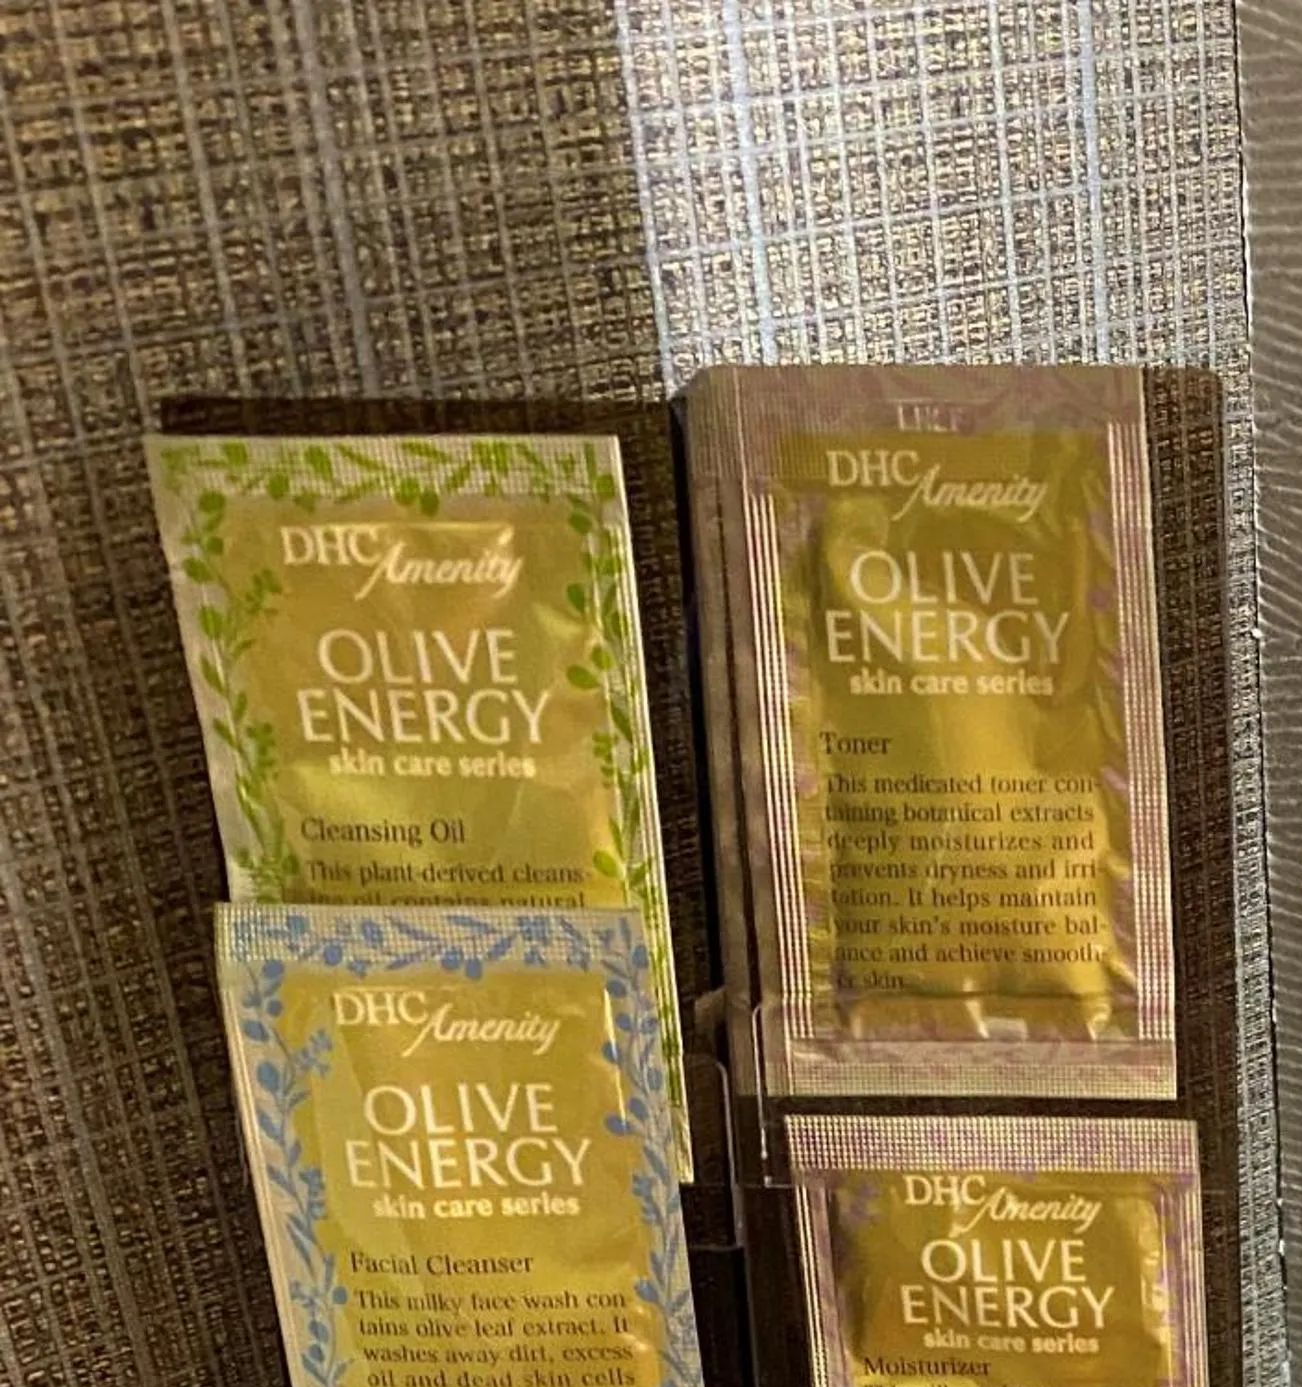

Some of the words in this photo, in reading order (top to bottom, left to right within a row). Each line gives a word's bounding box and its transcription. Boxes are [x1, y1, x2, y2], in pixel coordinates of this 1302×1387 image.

[826, 451, 920, 486] DHC
[892, 464, 1048, 522] Amenity
[281, 527, 381, 565] DHC
[354, 539, 524, 600] Amenity
[850, 550, 1038, 605] OLIVE
[318, 630, 517, 684] OLIVE
[825, 611, 1070, 664] ENERGY
[850, 668, 901, 694] skin
[911, 674, 968, 693] care
[976, 668, 1053, 695] series
[297, 691, 550, 745] ENERGY
[329, 751, 383, 776] skin
[394, 757, 451, 777] care
[458, 751, 537, 778] series
[820, 732, 892, 755] Toner
[302, 819, 422, 847] Cleansing
[430, 819, 466, 843] Oil
[932, 889, 991, 911] helps
[1000, 889, 1096, 906] maintain
[332, 991, 428, 1026] DHC
[400, 1003, 560, 1058] Amenity
[364, 1082, 558, 1135] OLIVE
[346, 1138, 592, 1189] ENERGY
[374, 1196, 425, 1219] skin
[434, 1199, 493, 1218] care
[501, 1193, 581, 1217] series
[903, 1175, 985, 1205] DHC
[950, 1188, 1103, 1237] Amenity
[351, 1251, 418, 1275] Facial
[427, 1255, 534, 1276] Cleanser
[921, 1239, 1086, 1284] OLIVE
[900, 1286, 1115, 1329] ENERGY
[924, 1330, 970, 1348] skin
[978, 1334, 1025, 1352] care
[1032, 1333, 1099, 1353] series
[368, 1370, 394, 1387] oil
[405, 1372, 446, 1387] and
[525, 1369, 571, 1387] skin
[582, 1368, 635, 1386] cells
[863, 1357, 991, 1376] Moisturizer
